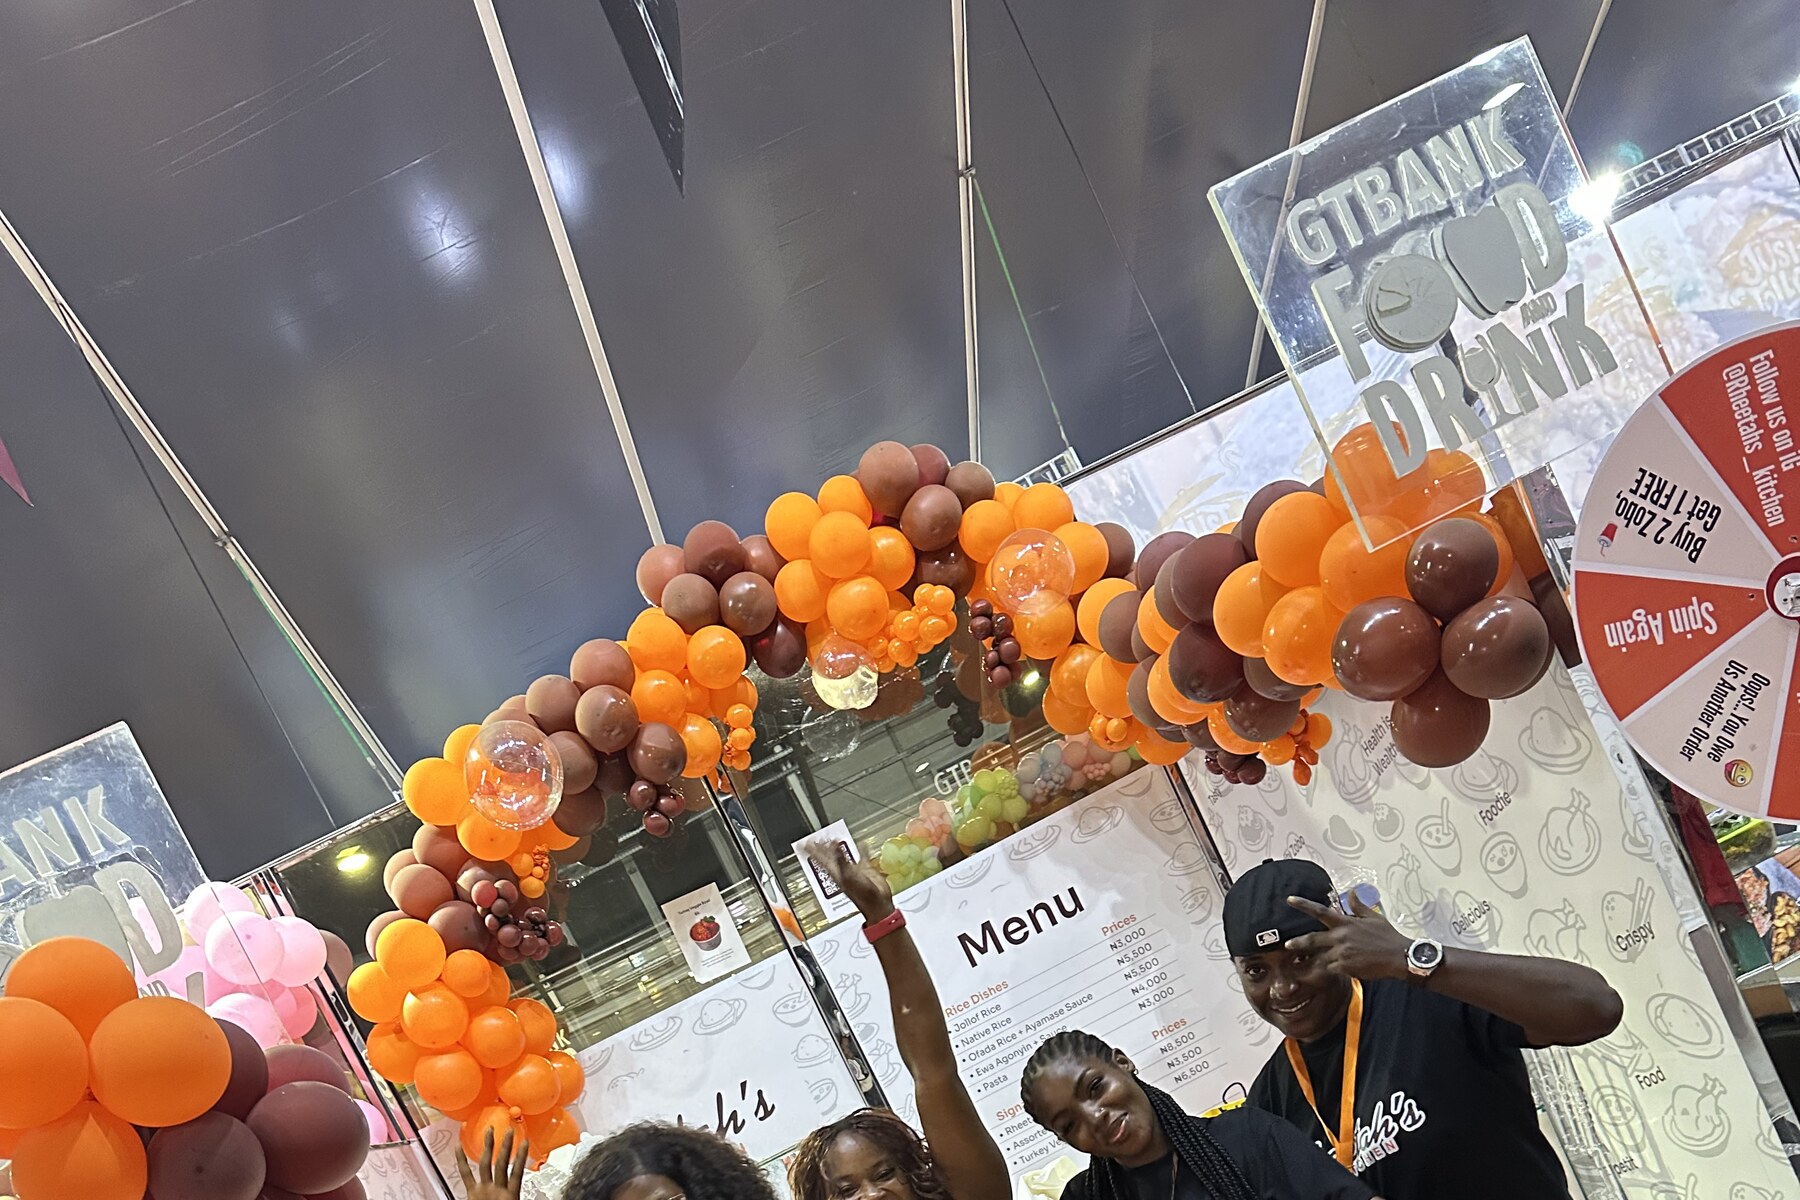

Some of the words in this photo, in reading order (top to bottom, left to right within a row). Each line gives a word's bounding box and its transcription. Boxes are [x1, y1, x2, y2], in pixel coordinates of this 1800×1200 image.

[1286, 108, 1527, 266] GTBANK
[1520, 291, 1557, 329] AND
[1749, 349, 1780, 405] Follow
[1765, 406, 1786, 429] us
[1772, 429, 1794, 452] on
[1629, 467, 1677, 511] FREE
[1673, 490, 1688, 515] 1
[1615, 490, 1657, 537] Zobo,
[1686, 495, 1722, 532] Get
[1653, 517, 1672, 545] 2
[1670, 521, 1707, 564] Buy
[1604, 608, 1664, 652] Again
[1668, 596, 1718, 639] Spin
[1724, 659, 1748, 679] Us
[1698, 677, 1736, 728] Another
[1361, 723, 1386, 757] Health
[1721, 712, 1749, 737] You
[1679, 726, 1710, 762] Order
[1707, 735, 1735, 763] Owe
[1478, 791, 1512, 826] Foodie
[957, 886, 1085, 968] Menu
[1101, 914, 1138, 937] Prices
[1452, 900, 1491, 935] Delicious
[1616, 921, 1655, 951] Crispy
[945, 1001, 970, 1018] Rice
[970, 980, 1009, 1006] Dishes
[954, 1013, 980, 1033] Jollof
[980, 1003, 1002, 1019] Rice
[960, 1027, 990, 1047] Native
[990, 1016, 1012, 1033] Rice
[968, 1043, 996, 1062] Ofada
[996, 1031, 1018, 1048] Rice
[1024, 1006, 1065, 1035] Ayamase
[1064, 992, 1094, 1011] Sauce
[1151, 1017, 1188, 1041] Prices
[975, 1063, 994, 1077] Ewa
[995, 1041, 1033, 1067] Agonyin
[982, 1075, 1009, 1092] Pasta
[1635, 1065, 1667, 1090] Food
[996, 1101, 1024, 1121] Sign
[1004, 1117, 1032, 1136] Rheet
[1013, 1128, 1048, 1150] Assorte
[1019, 1146, 1049, 1164] Turkey
